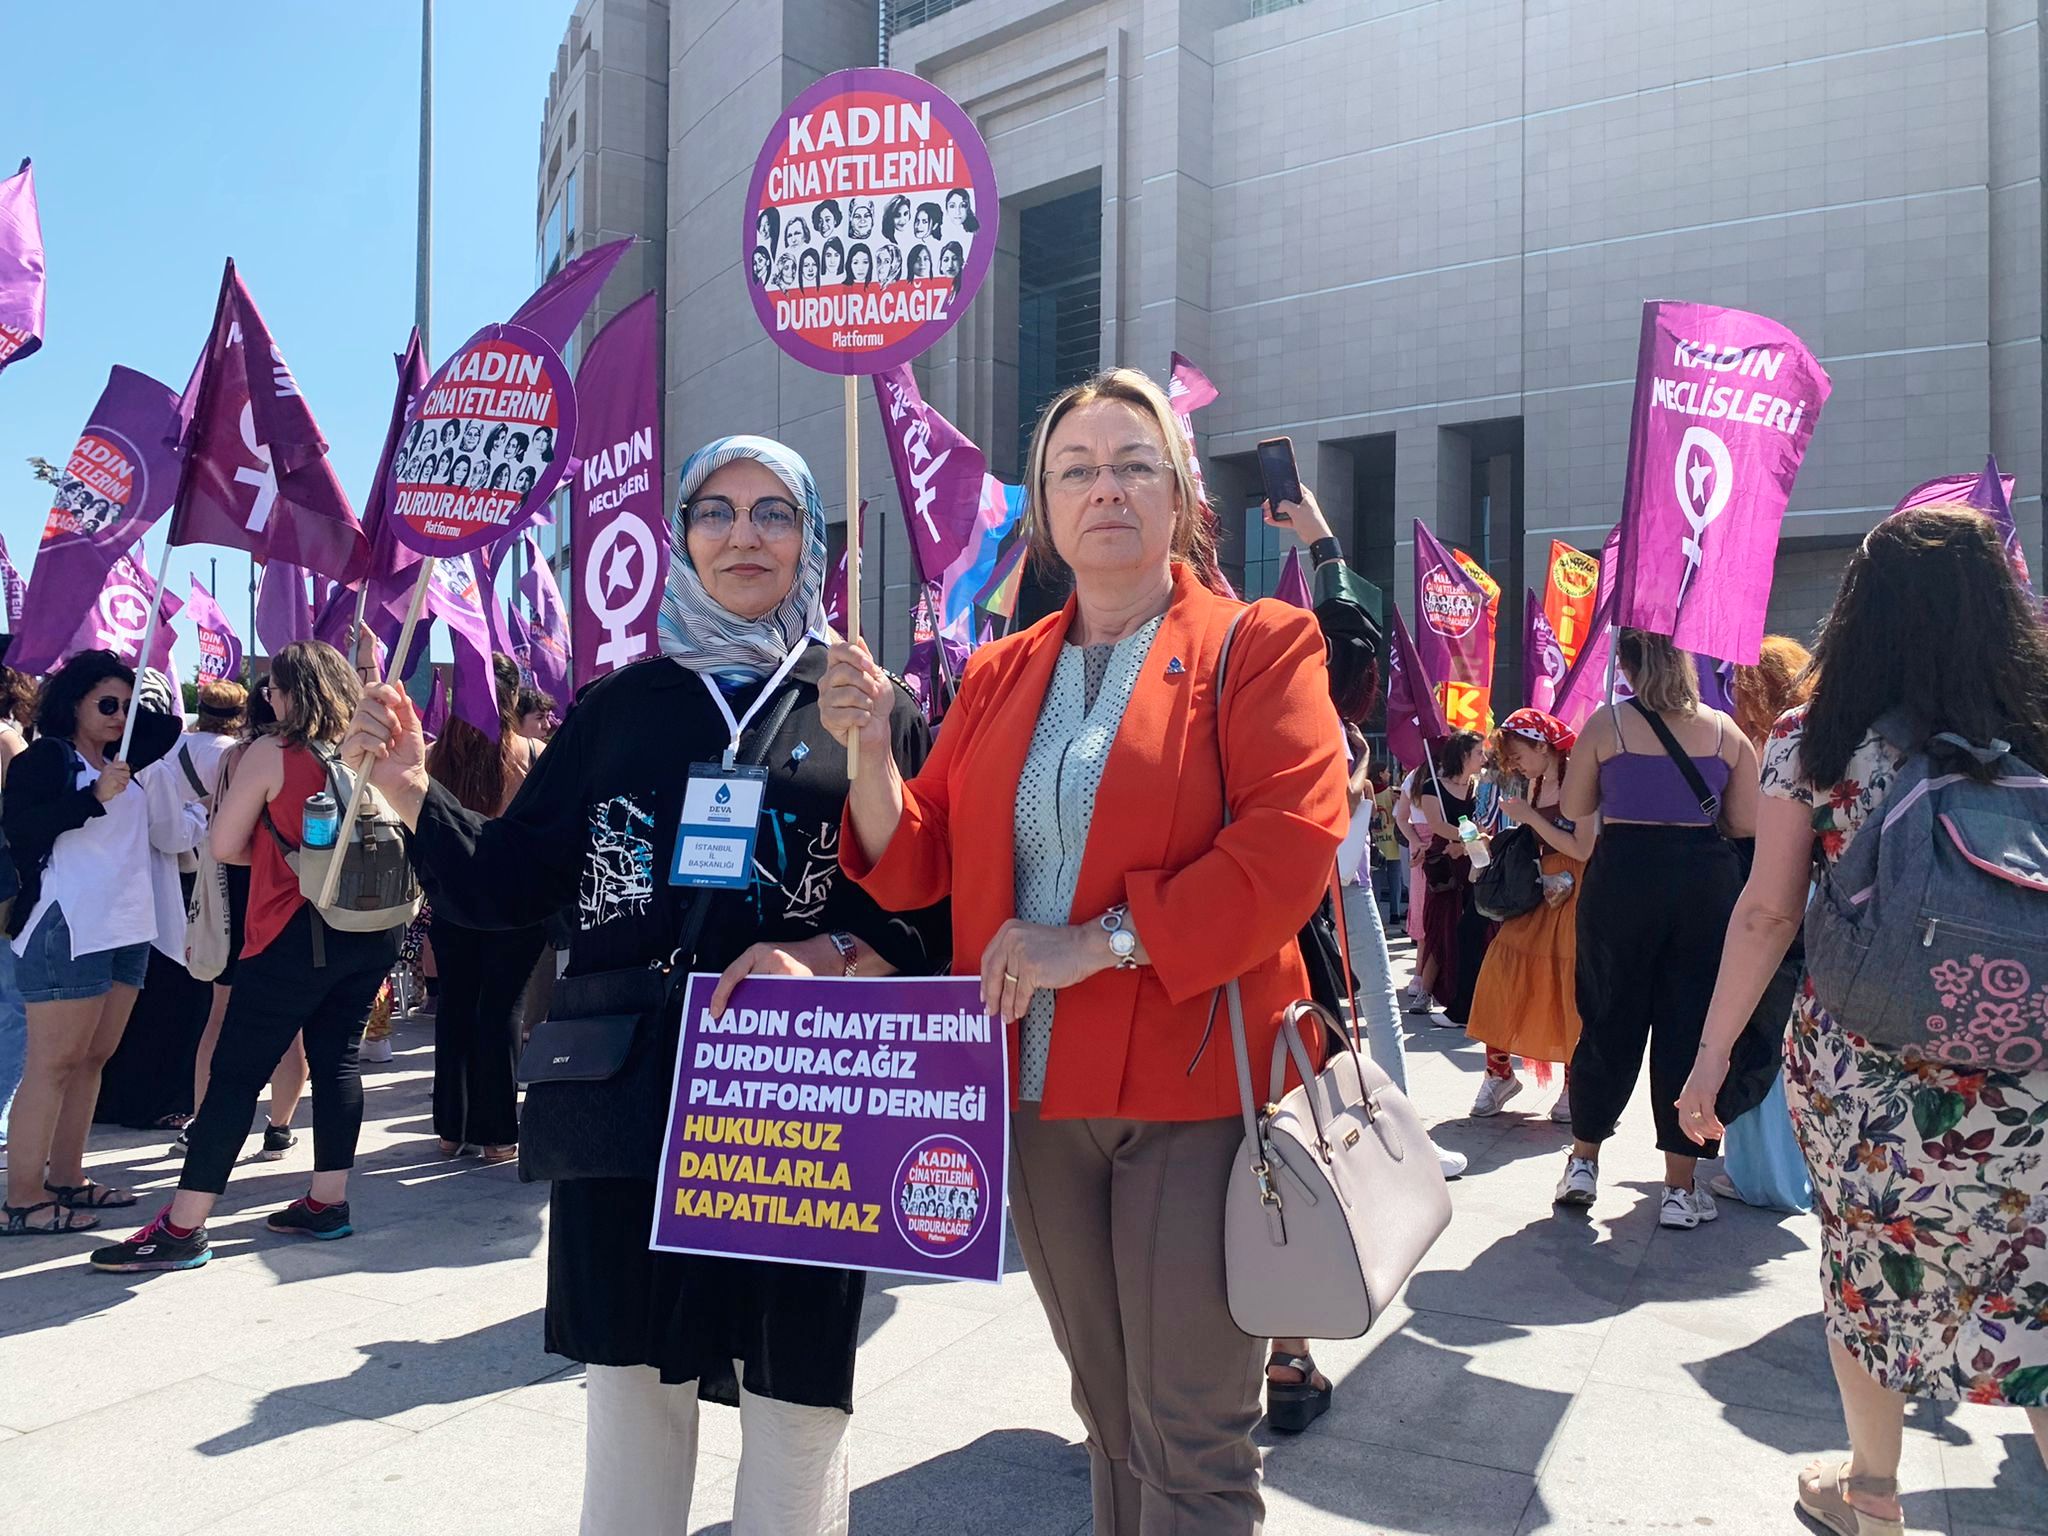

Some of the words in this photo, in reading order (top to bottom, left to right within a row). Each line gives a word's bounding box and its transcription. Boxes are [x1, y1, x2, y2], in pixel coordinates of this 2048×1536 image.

[789, 101, 930, 155] KADIN
[769, 139, 954, 202] CİNAYETLERİNİ
[777, 280, 948, 331] DURDURACAĞIZ
[833, 330, 884, 347] Platformu
[445, 352, 544, 385] KADIN
[1674, 339, 1785, 381] KADIN
[423, 384, 552, 421] CİNAYETLERİNİ
[1652, 376, 1805, 435] MECLİSLERİ
[75, 437, 135, 479] ADIN
[584, 427, 652, 492] KADIN
[394, 490, 516, 525] DURDURACAĞIZ
[424, 520, 461, 537] Platformu
[688, 859, 734, 869] BAŞKANLIĞI
[695, 842, 732, 852] İSTANBUL
[699, 1007, 787, 1037] KADIN
[794, 1006, 990, 1043] CİNAYETLERİNİ
[694, 1042, 917, 1079] DURDURACAĞIZ
[689, 1079, 862, 1115] PLATFORMU
[868, 1085, 986, 1121] DERNEĞİ
[683, 1115, 842, 1151] HUKUKSUZ
[679, 1151, 851, 1191] DAVALARLA
[909, 1166, 973, 1186] CİNAYETLERİNİ
[918, 1151, 967, 1169] KADIN
[675, 1188, 880, 1233] KAPATILAMAZ
[908, 1219, 969, 1236] DURDURACAĞIZ
